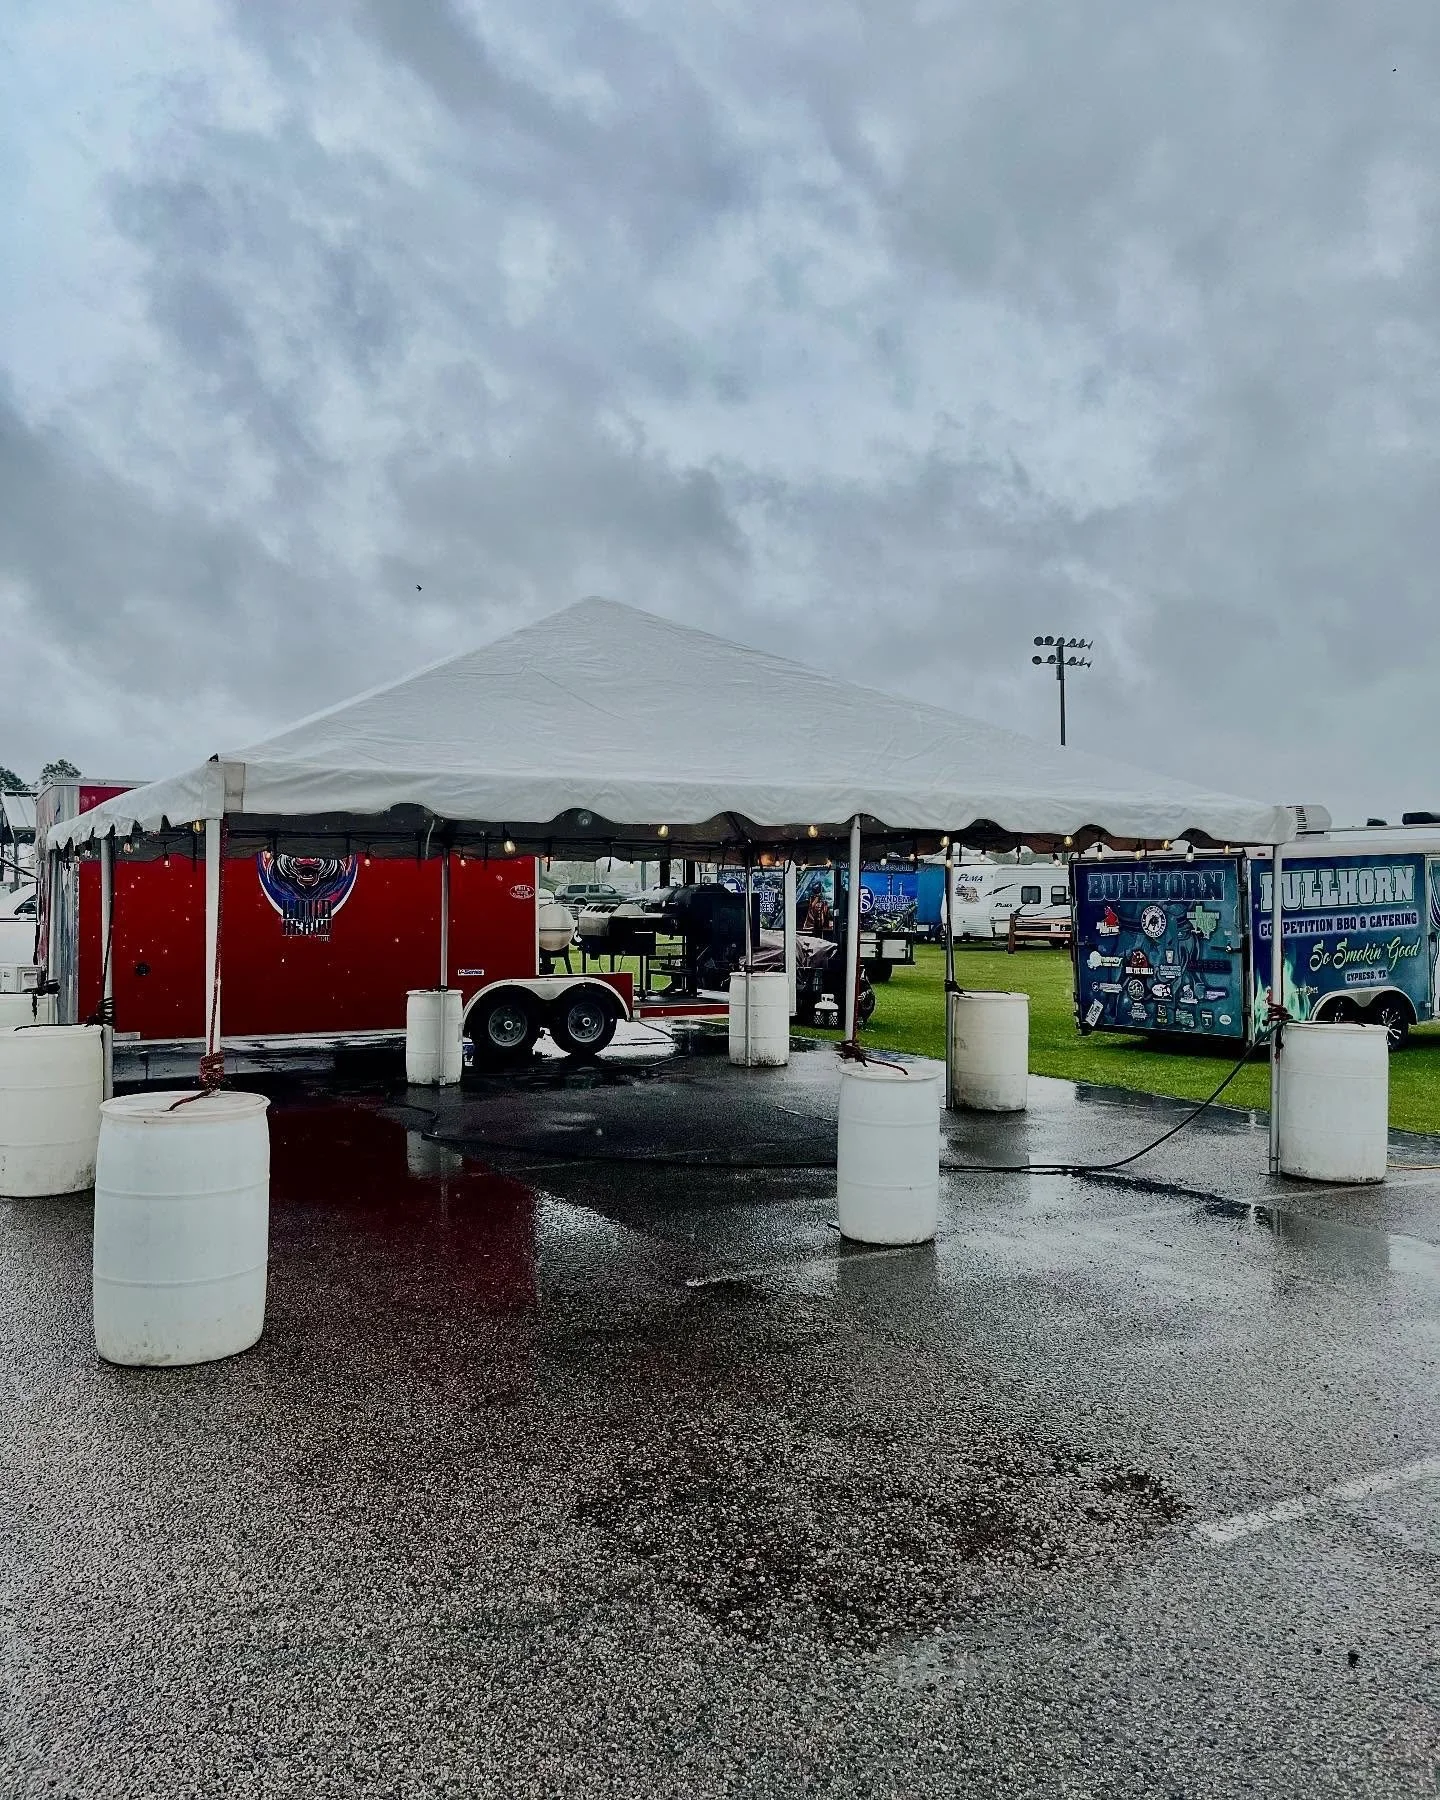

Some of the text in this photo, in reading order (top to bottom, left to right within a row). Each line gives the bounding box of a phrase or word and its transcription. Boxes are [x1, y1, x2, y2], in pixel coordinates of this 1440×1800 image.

[1087, 871, 1226, 901] BULLHORN
[1260, 912, 1417, 937] COPETITION BBQ & CATERING
[1309, 940, 1331, 972] So
[1386, 936, 1421, 972] Good
[1346, 969, 1387, 982] CYPRESS, TX
